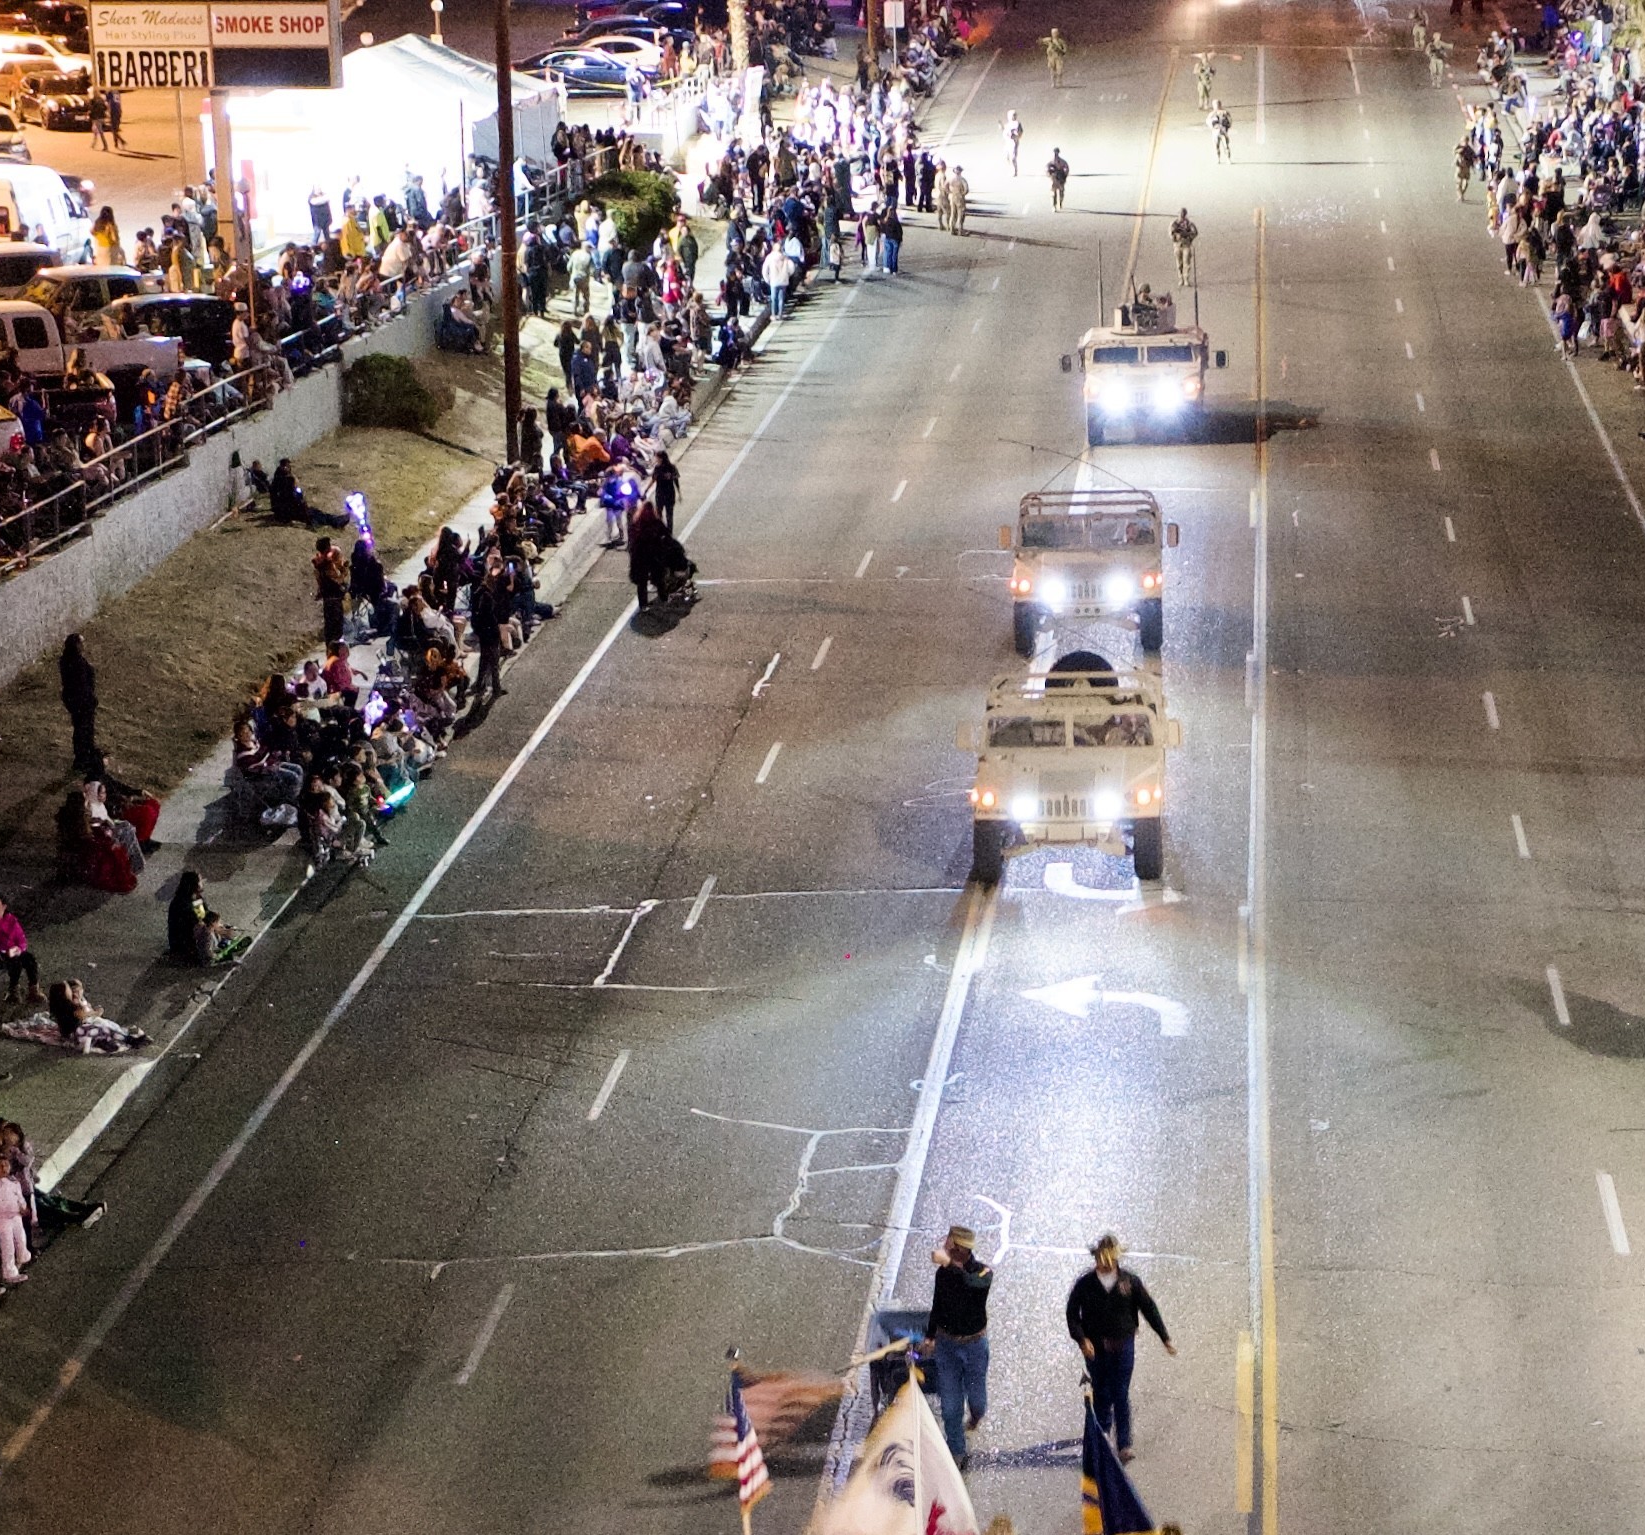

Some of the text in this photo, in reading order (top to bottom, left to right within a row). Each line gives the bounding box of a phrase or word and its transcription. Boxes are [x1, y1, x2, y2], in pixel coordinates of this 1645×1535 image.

[97, 9, 203, 26] Shear Madness
[216, 15, 325, 34] SMOKE SHOP
[105, 31, 196, 42] Hair Styling Plus
[108, 51, 198, 87] BARBER
